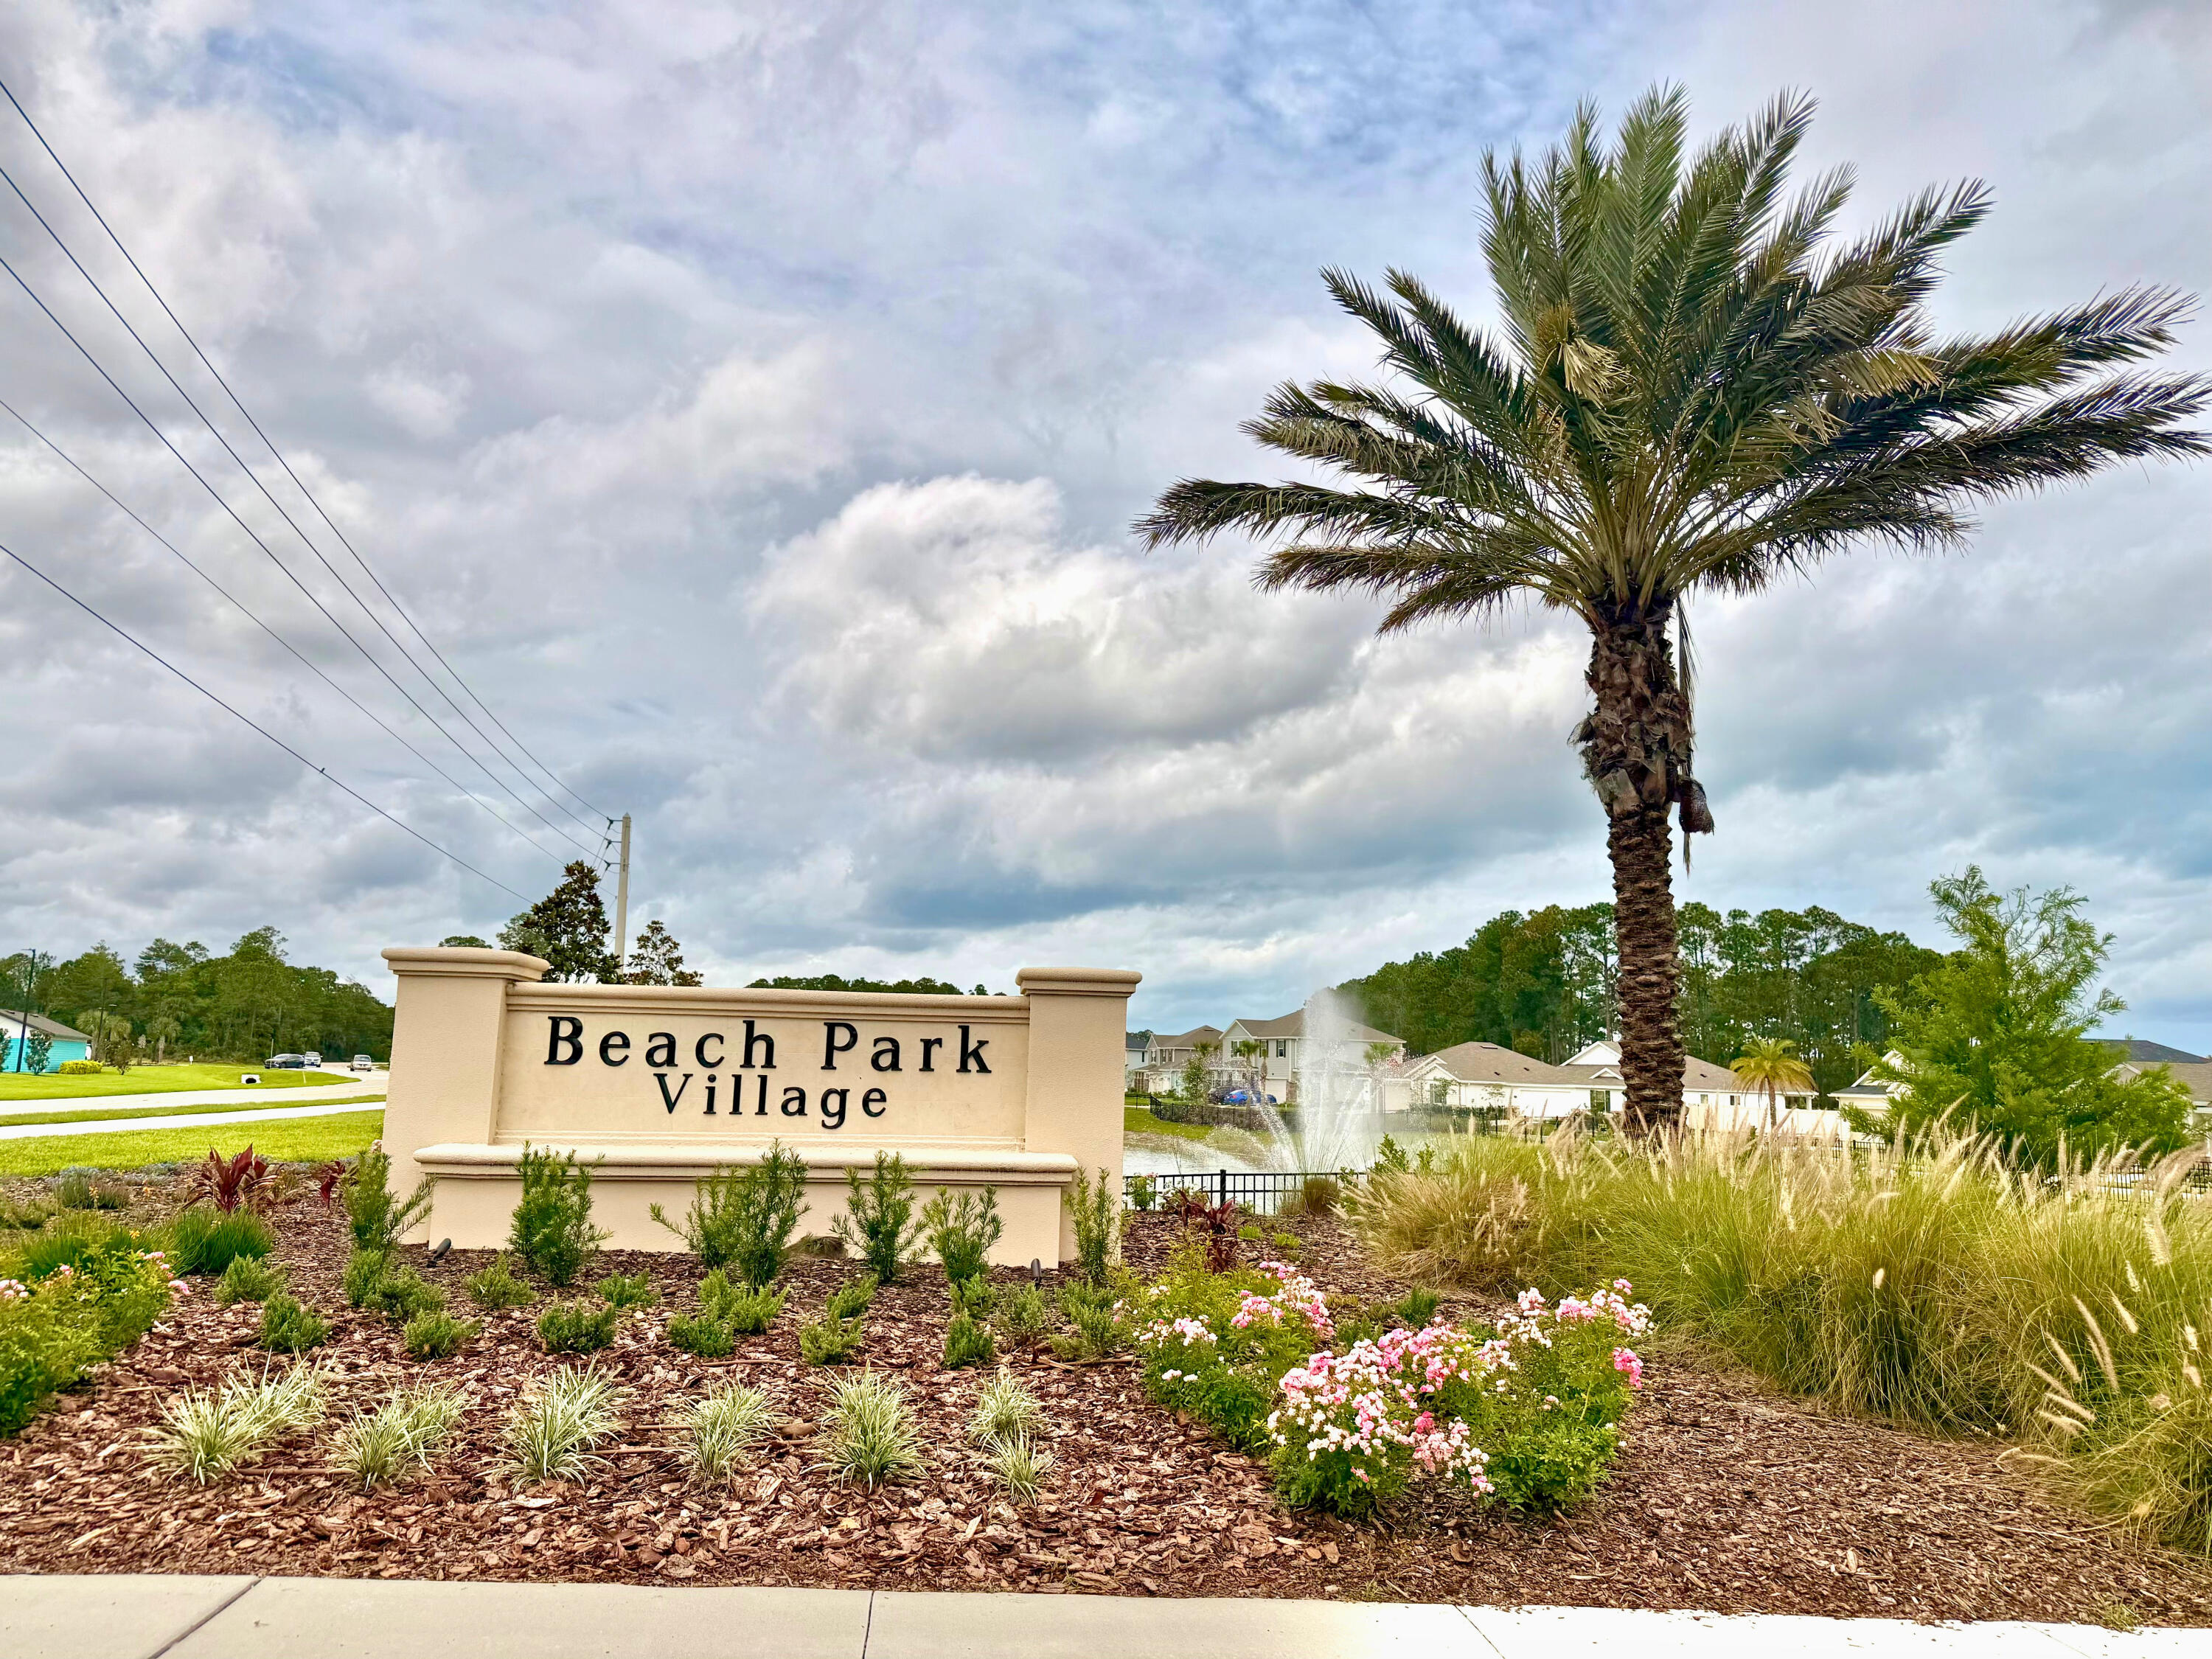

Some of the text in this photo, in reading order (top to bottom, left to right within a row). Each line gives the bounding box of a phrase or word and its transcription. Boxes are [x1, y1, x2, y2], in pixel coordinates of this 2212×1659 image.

[543, 1015, 992, 1074] Beach Park
[653, 1073, 887, 1130] Village
